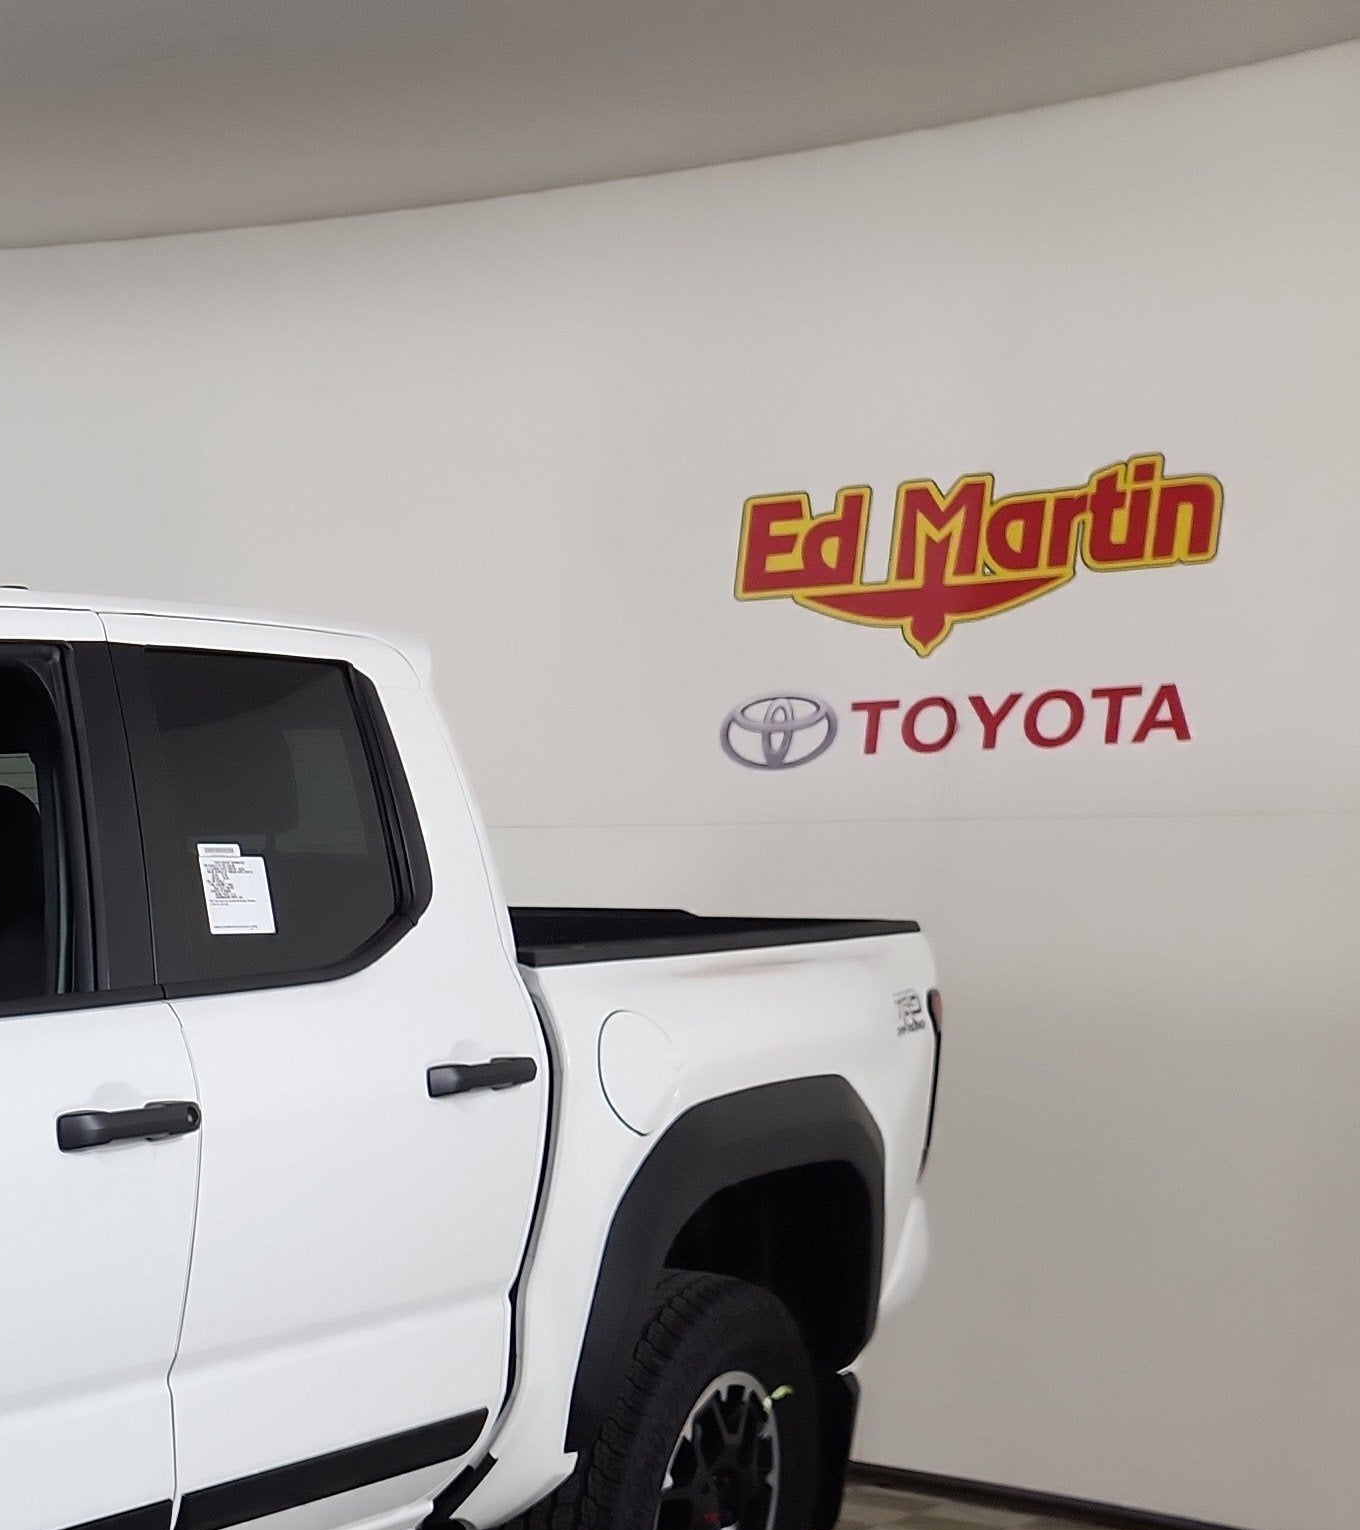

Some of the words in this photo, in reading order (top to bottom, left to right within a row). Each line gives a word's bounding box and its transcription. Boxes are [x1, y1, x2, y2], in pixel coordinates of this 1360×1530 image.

[738, 490, 868, 596] Ed
[892, 457, 1219, 585] Martin
[850, 683, 1192, 756] TOYOTA
